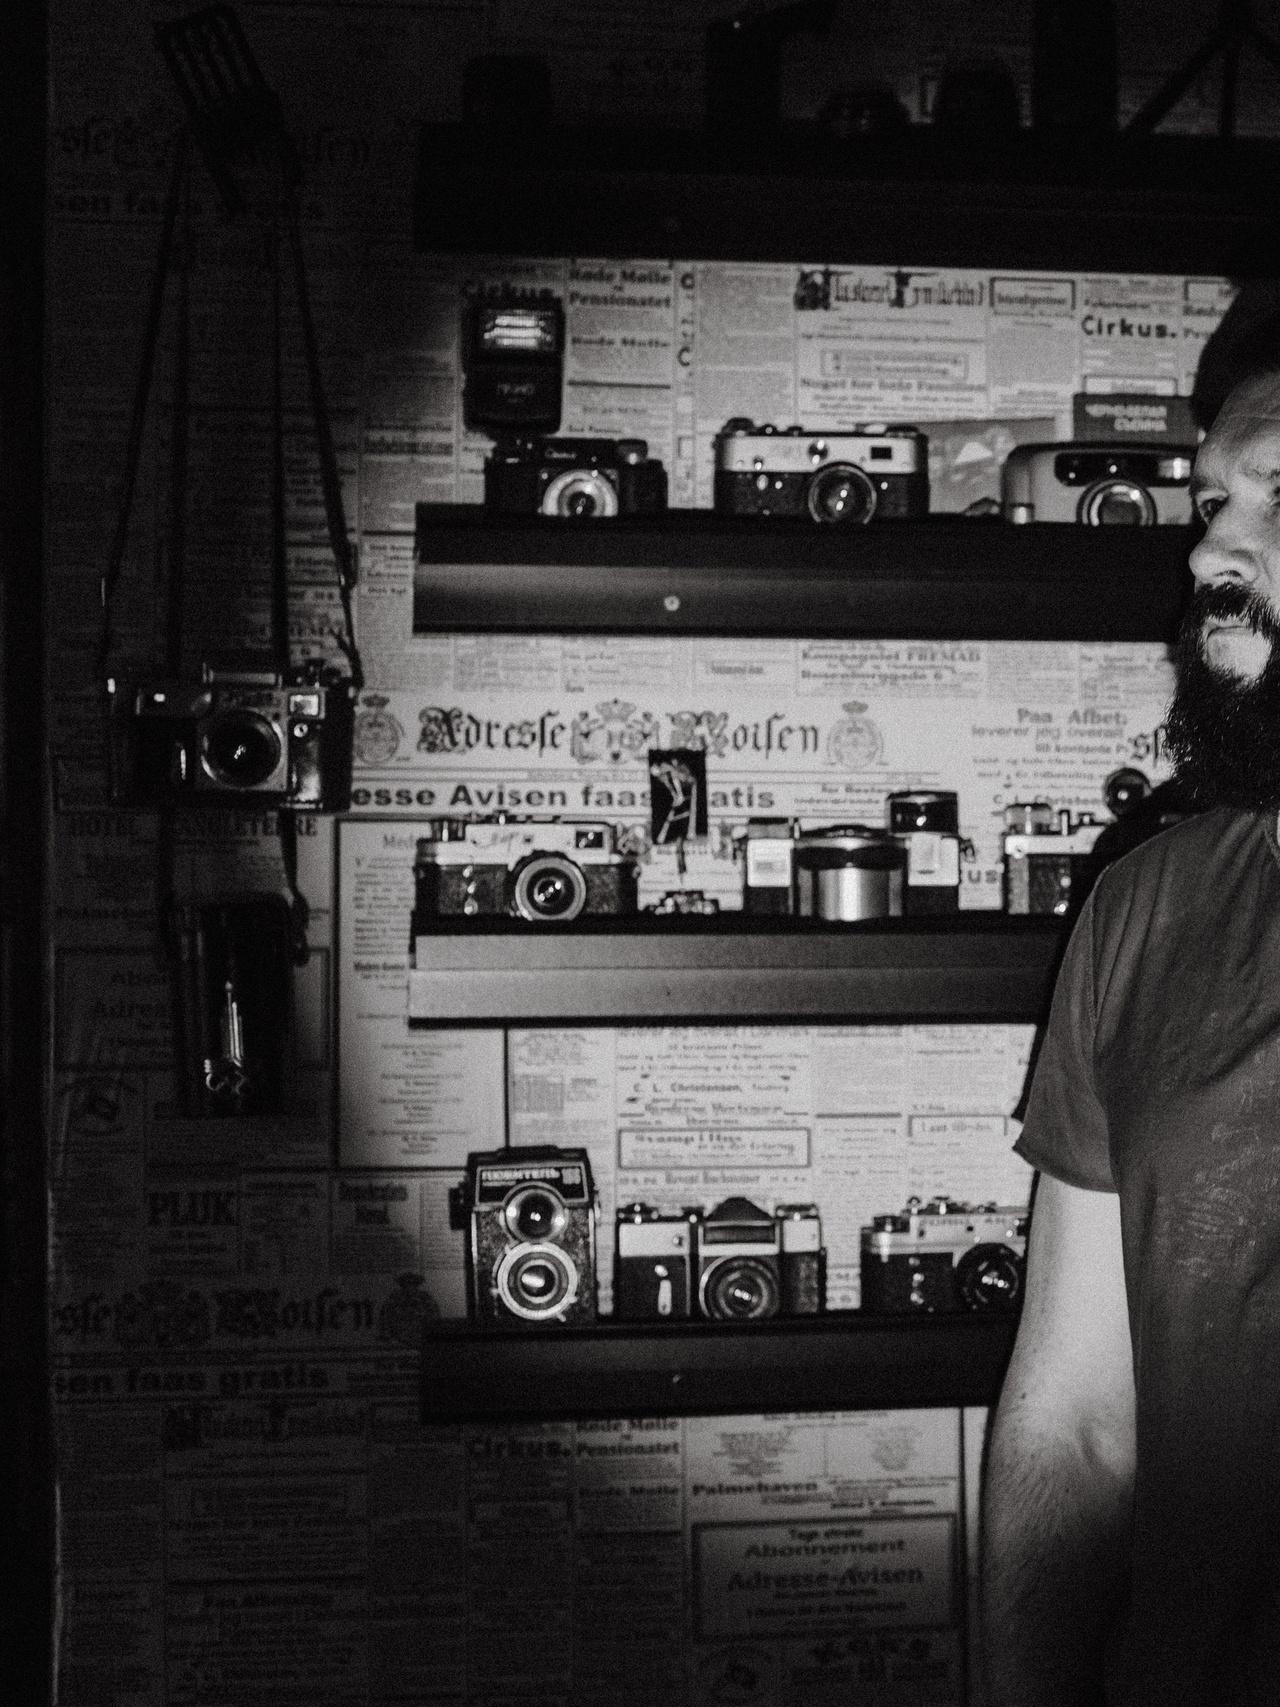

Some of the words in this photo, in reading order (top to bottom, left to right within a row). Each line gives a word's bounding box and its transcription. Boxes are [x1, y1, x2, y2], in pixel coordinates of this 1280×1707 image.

[1081, 315, 1177, 339] Cirkus.
[450, 783, 568, 808] Avisen
[710, 784, 776, 808] atis
[148, 1190, 238, 1227] PLUK
[219, 1363, 329, 1400] gratis
[744, 1538, 906, 1558] Abonnement
[727, 1566, 924, 1592] Adresse-Avisen
